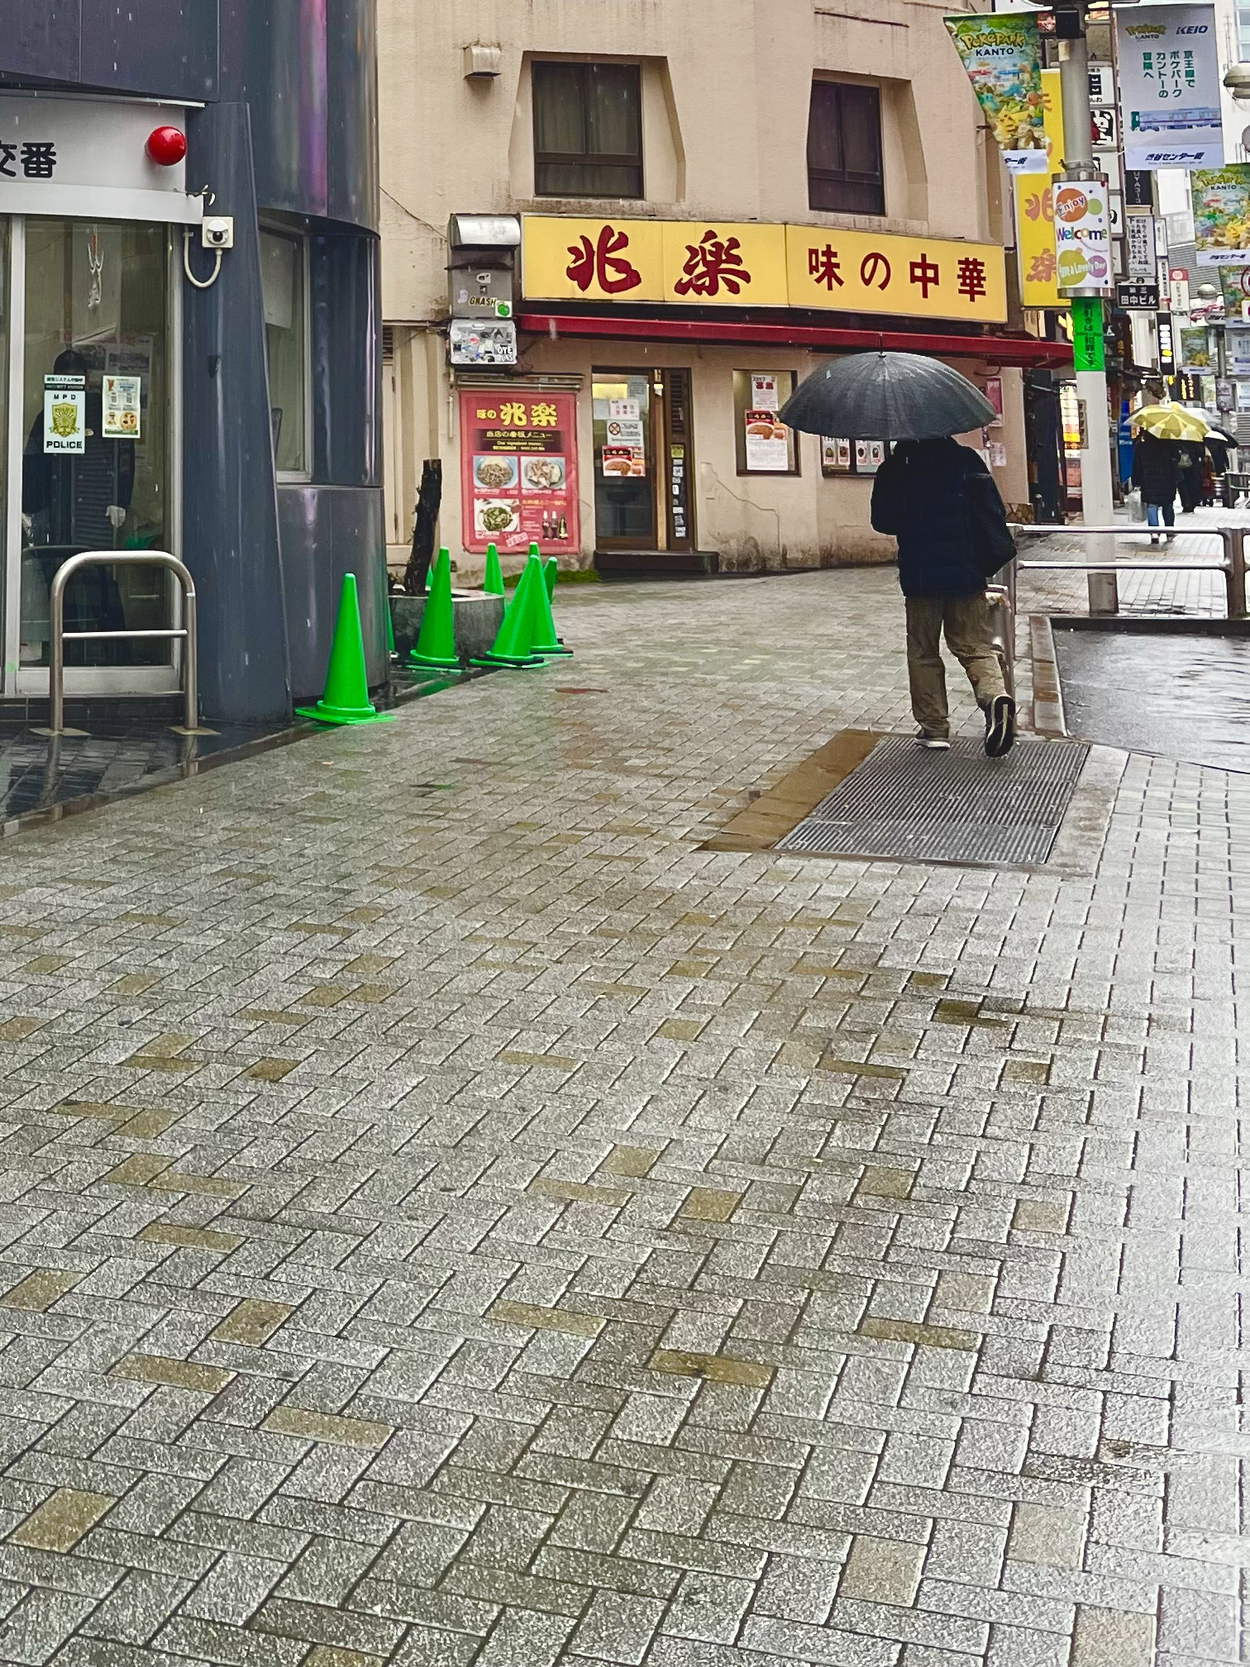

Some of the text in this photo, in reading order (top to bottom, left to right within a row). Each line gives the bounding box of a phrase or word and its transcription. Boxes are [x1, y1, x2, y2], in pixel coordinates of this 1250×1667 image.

[1175, 25, 1209, 35] KEIO
[975, 47, 1015, 57] KANTO
[1056, 195, 1085, 219] Enjoy
[1056, 226, 1108, 242] Welcome
[565, 224, 988, 303] 兆楽 味の中華
[1120, 294, 1157, 305] 田中ビル
[46, 440, 83, 449] POLICE
